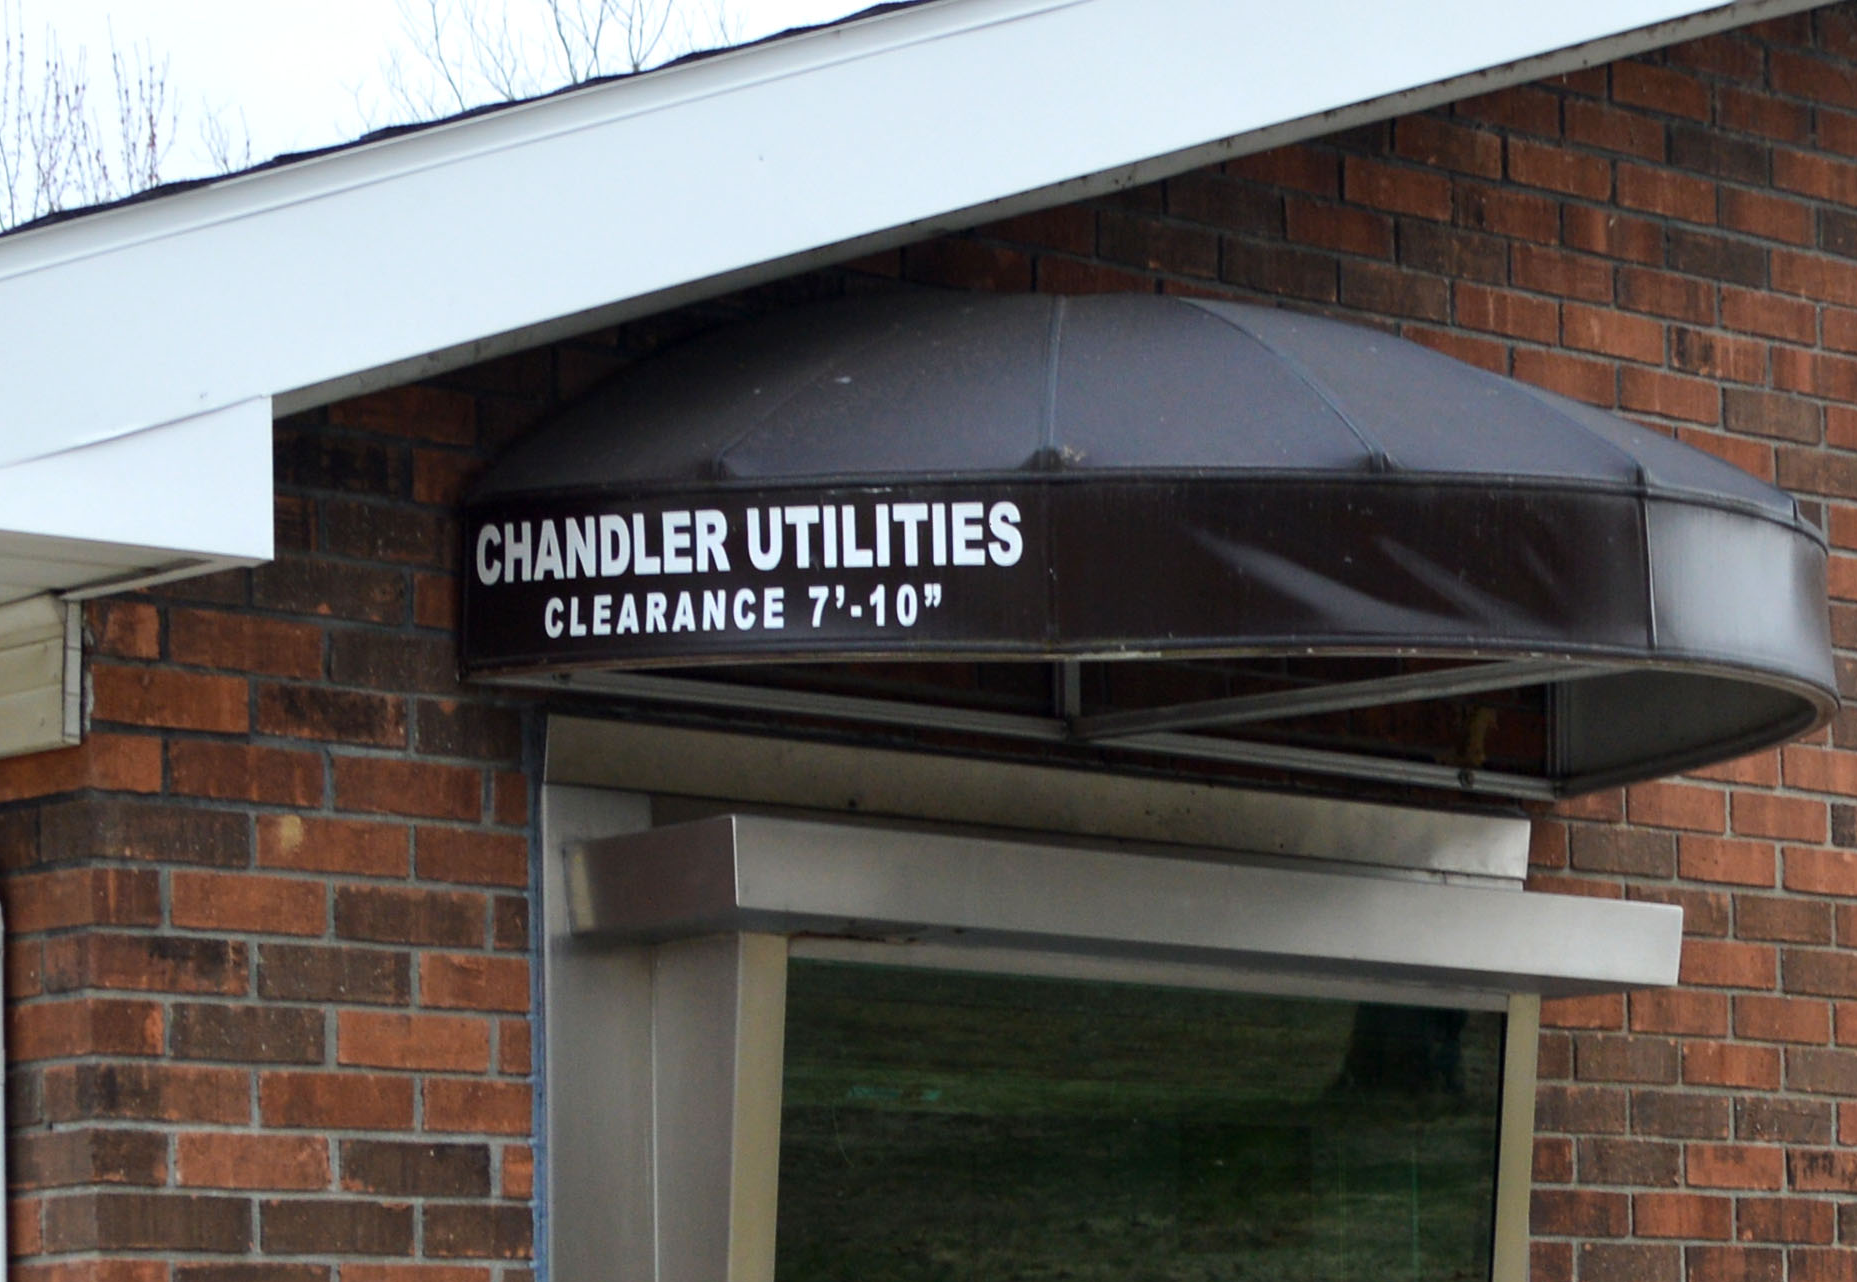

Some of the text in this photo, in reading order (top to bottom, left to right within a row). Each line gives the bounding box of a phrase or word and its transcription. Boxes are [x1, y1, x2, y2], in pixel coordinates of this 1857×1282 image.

[476, 501, 1023, 586] CHANDLER UTILITIES
[544, 586, 785, 639] CLEARANCE
